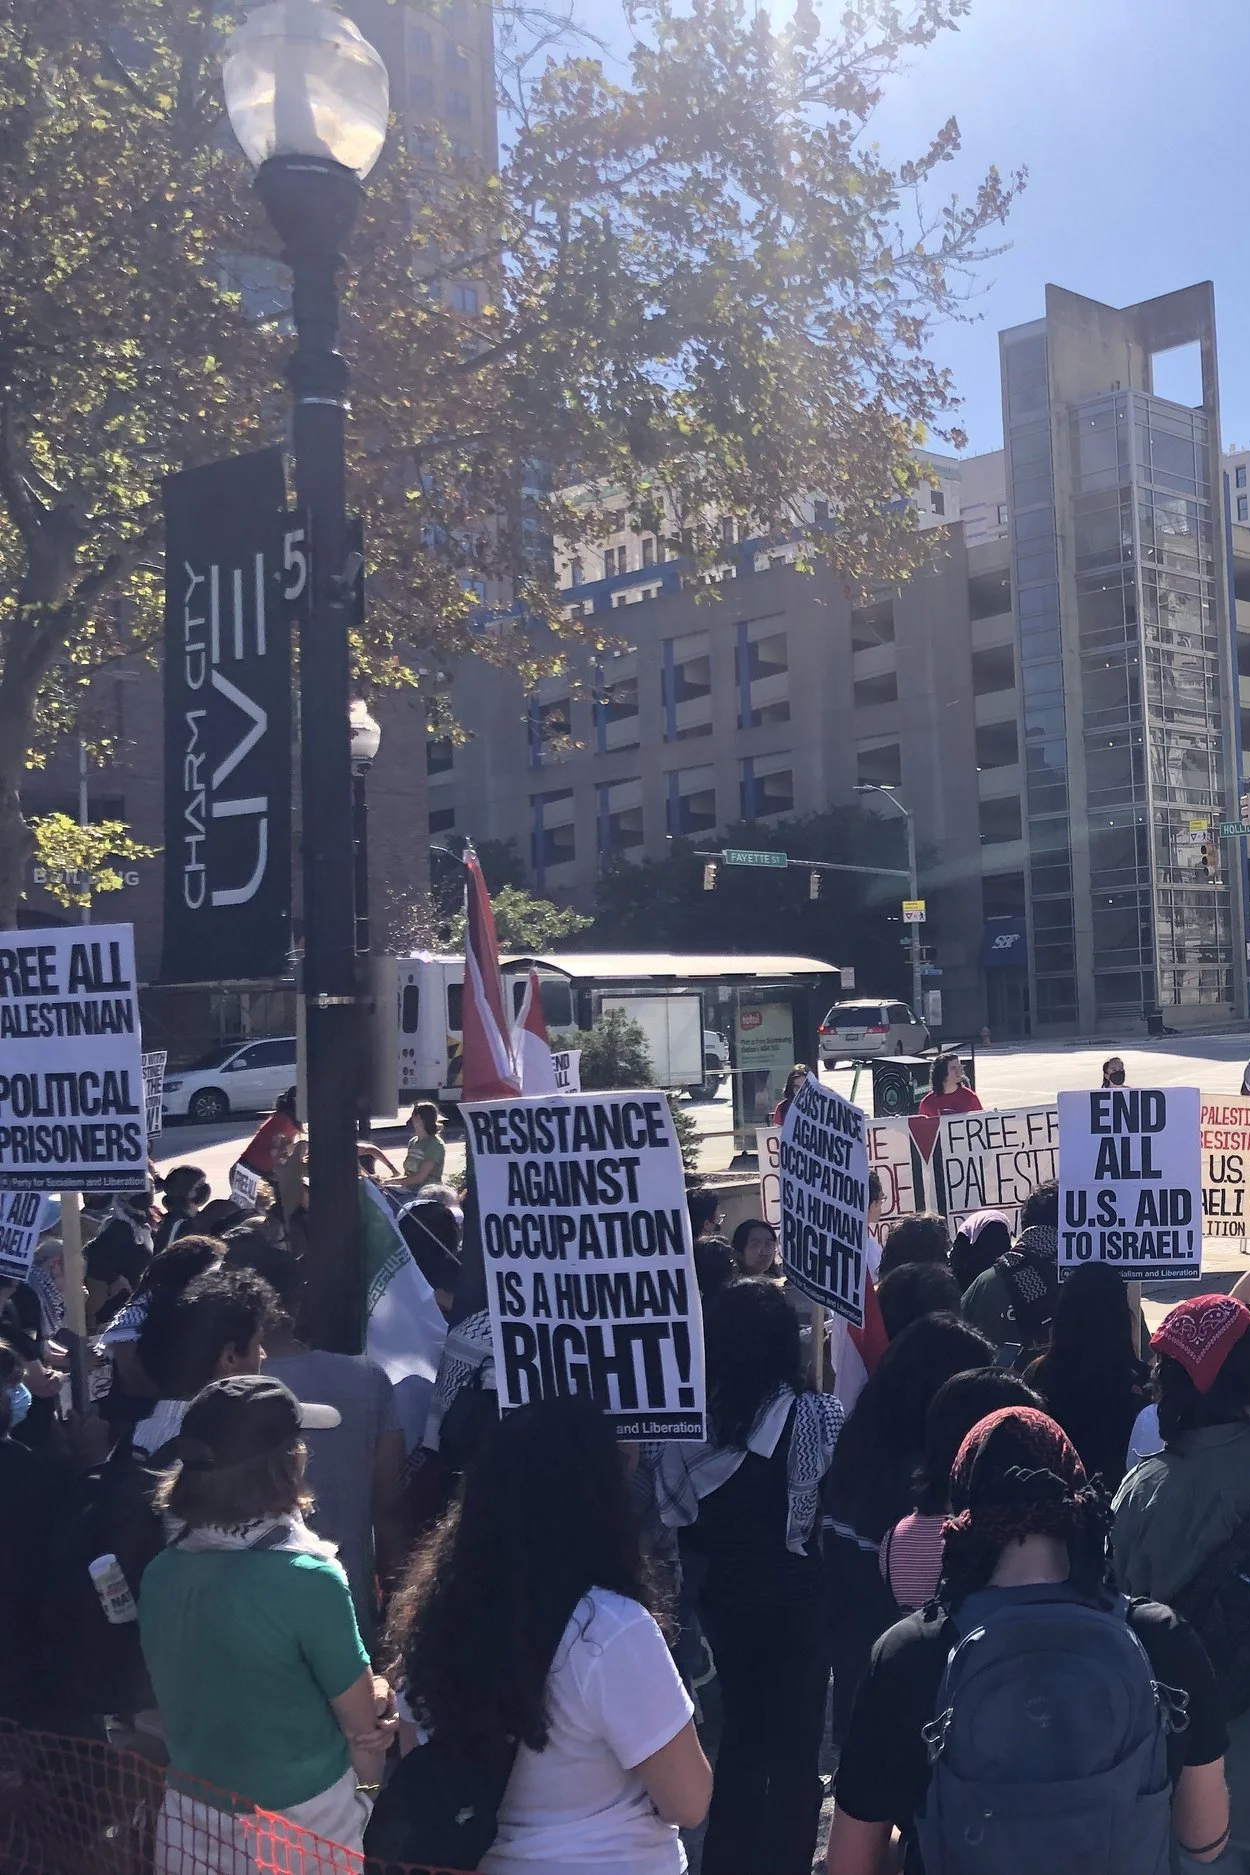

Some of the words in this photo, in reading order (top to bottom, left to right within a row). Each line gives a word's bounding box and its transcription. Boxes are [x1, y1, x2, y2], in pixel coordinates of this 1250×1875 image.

[184, 561, 206, 690] CITY
[185, 709, 207, 909] CHARM
[731, 852, 771, 864] FAYETTE
[772, 855, 781, 864] ST
[0, 945, 60, 998] REE
[68, 942, 131, 994] ALL
[0, 999, 134, 1039] ALESTINIAN
[0, 1071, 140, 1118] POLITICAL
[1090, 1090, 1167, 1134] END
[0, 1122, 142, 1164] PRISONERS
[469, 1102, 669, 1155] RESISTANCE
[792, 1115, 853, 1171] AGAINST
[947, 1115, 1025, 1153] FREE,
[781, 1141, 865, 1213] OCCUPATION
[1094, 1136, 1163, 1180] ALL
[1209, 1154, 1246, 1184] U.S.
[12, 1178, 32, 1188] Party
[34, 1178, 44, 1187] for
[46, 1177, 84, 1187] Socialism
[86, 1177, 102, 1187] and
[104, 1176, 145, 1187] Liberation
[508, 1157, 640, 1207] AGAINST
[6, 1193, 41, 1228] AID
[783, 1178, 794, 1210] IS
[796, 1188, 805, 1219] A
[807, 1195, 863, 1250] HUMAN
[1065, 1189, 1126, 1228] U.S.
[1135, 1188, 1192, 1227] AID
[484, 1209, 686, 1260] OCCUPATION
[1062, 1231, 1092, 1260] TO
[1101, 1230, 1194, 1260] ISRAEL!
[783, 1209, 861, 1307] RIGHT!
[1145, 1269, 1160, 1277] and
[1161, 1268, 1198, 1277] Liberation
[496, 1271, 526, 1318] IS
[533, 1271, 554, 1319] A
[556, 1268, 689, 1321] HUMAN
[502, 1321, 696, 1410] RIGHT!
[616, 1423, 639, 1434] and
[642, 1422, 701, 1434] Liberation
